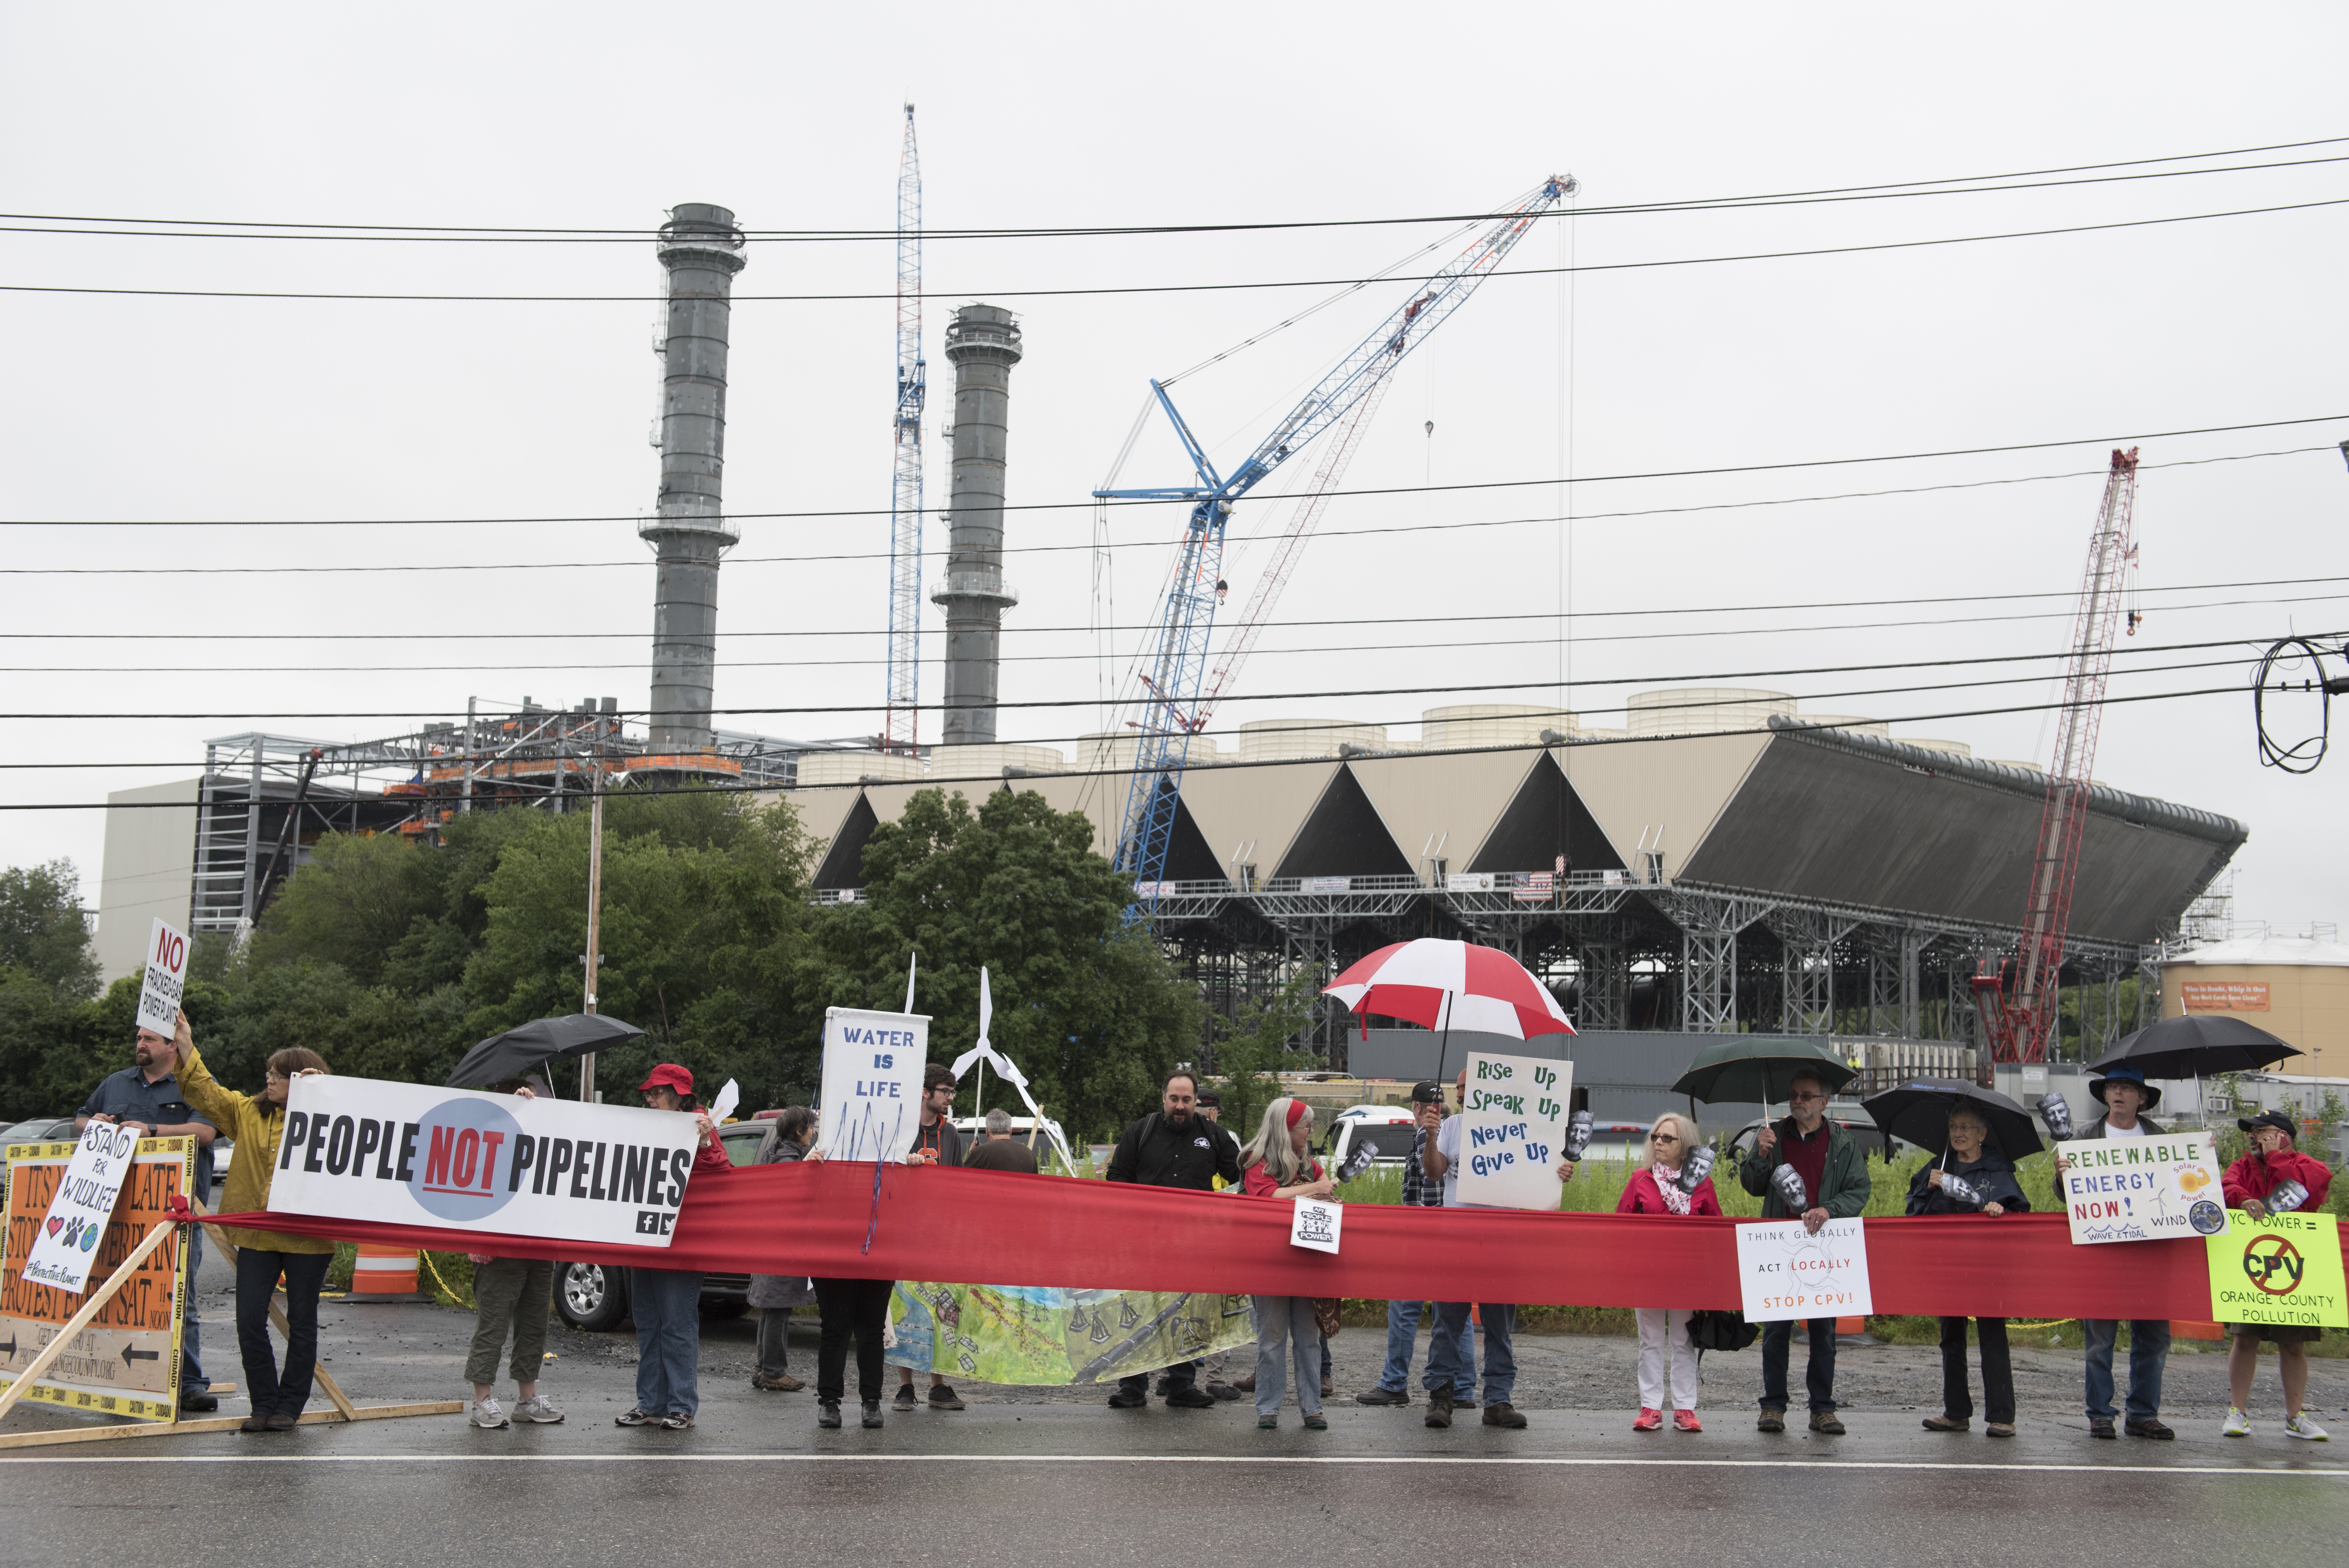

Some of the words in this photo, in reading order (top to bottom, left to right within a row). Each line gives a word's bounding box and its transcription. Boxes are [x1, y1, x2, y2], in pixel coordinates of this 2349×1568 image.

[156, 927, 184, 973] NO
[146, 966, 183, 1002] FRACKED-GAS
[143, 992, 160, 1019] POWER
[160, 1001, 178, 1027] PLANTS
[844, 1027, 914, 1047] WATER
[874, 1054, 894, 1069] IS
[856, 1080, 901, 1098] LIFE
[83, 1124, 130, 1159] #STAND
[143, 1140, 157, 1152] CAUTION
[168, 1139, 183, 1151] CUIDADO
[280, 1111, 420, 1182] PEOPLE
[424, 1126, 504, 1190] NOT
[508, 1134, 691, 1207] PIPELINES
[2067, 1144, 2199, 1169] RENEWABLE
[92, 1158, 108, 1176] FOR
[2173, 1163, 2197, 1174] Solar
[25, 1165, 52, 1209] ITS
[130, 1164, 176, 1212] LATE
[2071, 1172, 2155, 1194] ENERGY
[63, 1175, 118, 1213] WILDLIFE
[1303, 1212, 1331, 1221] PEOPLE
[2151, 1215, 2187, 1227] WIND
[1300, 1232, 1331, 1240] POWER
[1747, 1231, 1784, 1242] THINK
[1794, 1228, 1855, 1239] GLOBALLY
[2088, 1231, 2114, 1241] WAVE
[2123, 1229, 2148, 1239] TIDAL
[1759, 1263, 1781, 1272] ACT
[1792, 1259, 1850, 1271] LOCALLY
[2243, 1254, 2304, 1280] CPV
[118, 1278, 151, 1327] SAT
[1764, 1296, 1805, 1308] STOP
[1815, 1292, 1853, 1305] CPV!
[2221, 1291, 2272, 1304] ORANGE
[2279, 1295, 2334, 1308] COUNTY
[149, 1310, 171, 1330] NOON
[2242, 1309, 2320, 1324] POLLUTION
[101, 1396, 116, 1410] CUIDADO
[129, 1400, 144, 1415] CAUTION
[155, 1403, 171, 1418] CUIDADO
